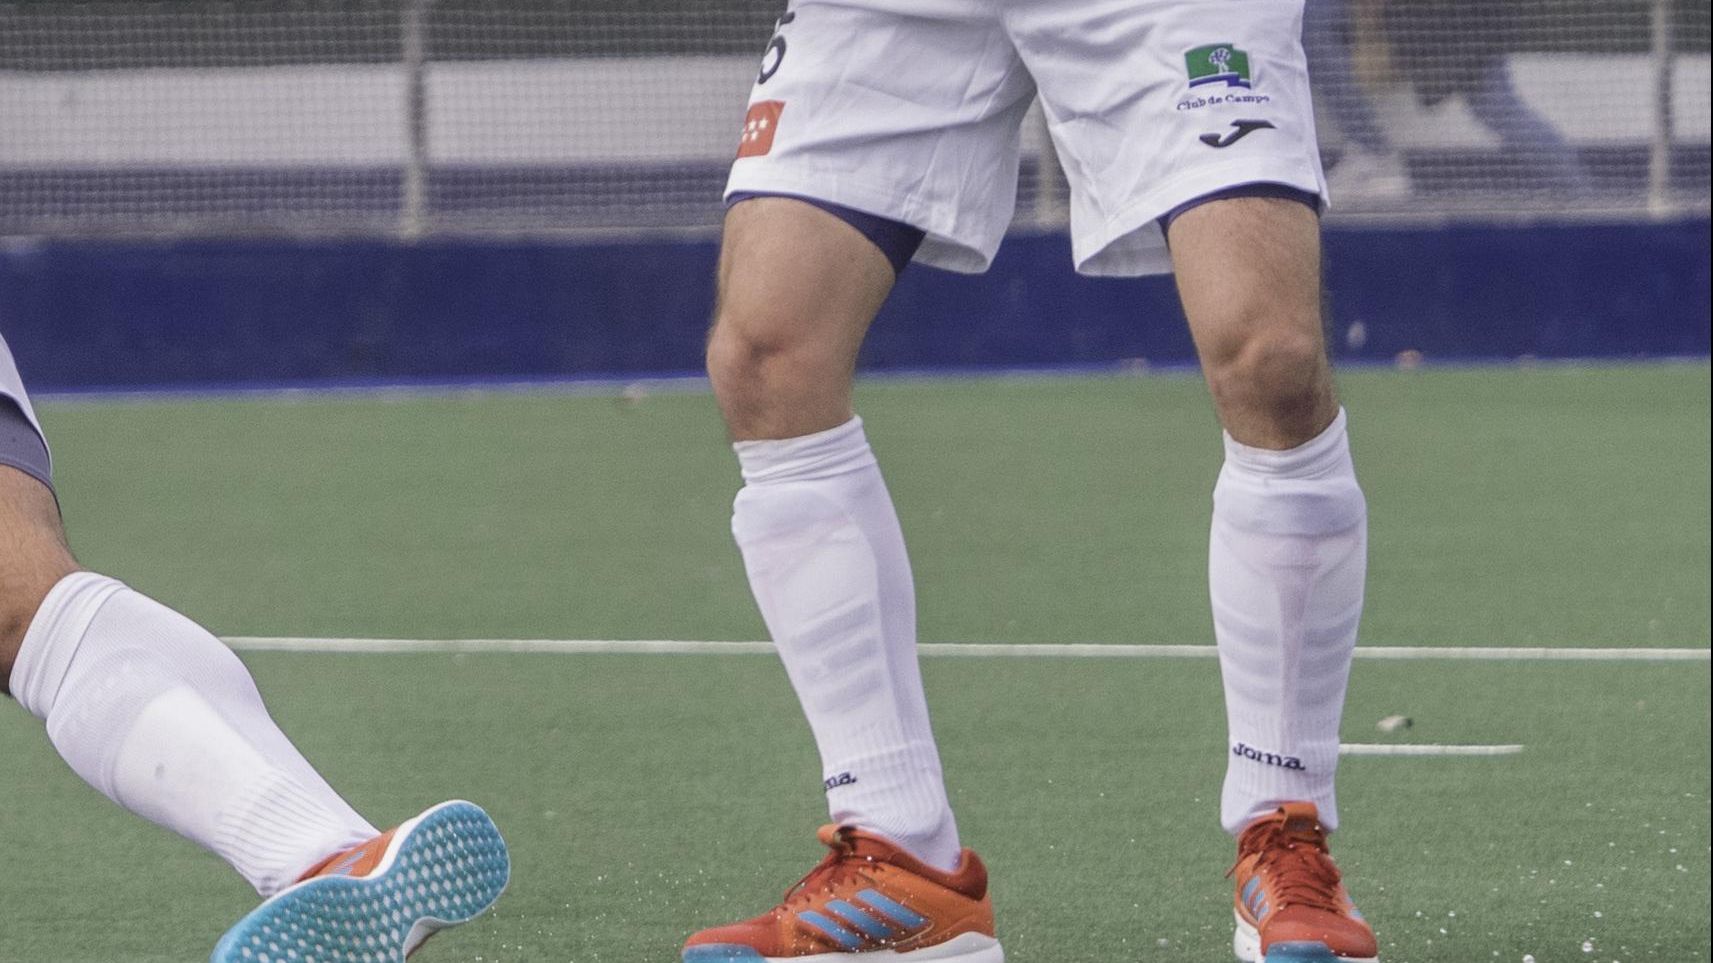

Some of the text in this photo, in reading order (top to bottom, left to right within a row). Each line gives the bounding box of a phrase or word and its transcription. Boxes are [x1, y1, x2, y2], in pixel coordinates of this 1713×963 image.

[1176, 94, 1271, 111] Club de Campo
